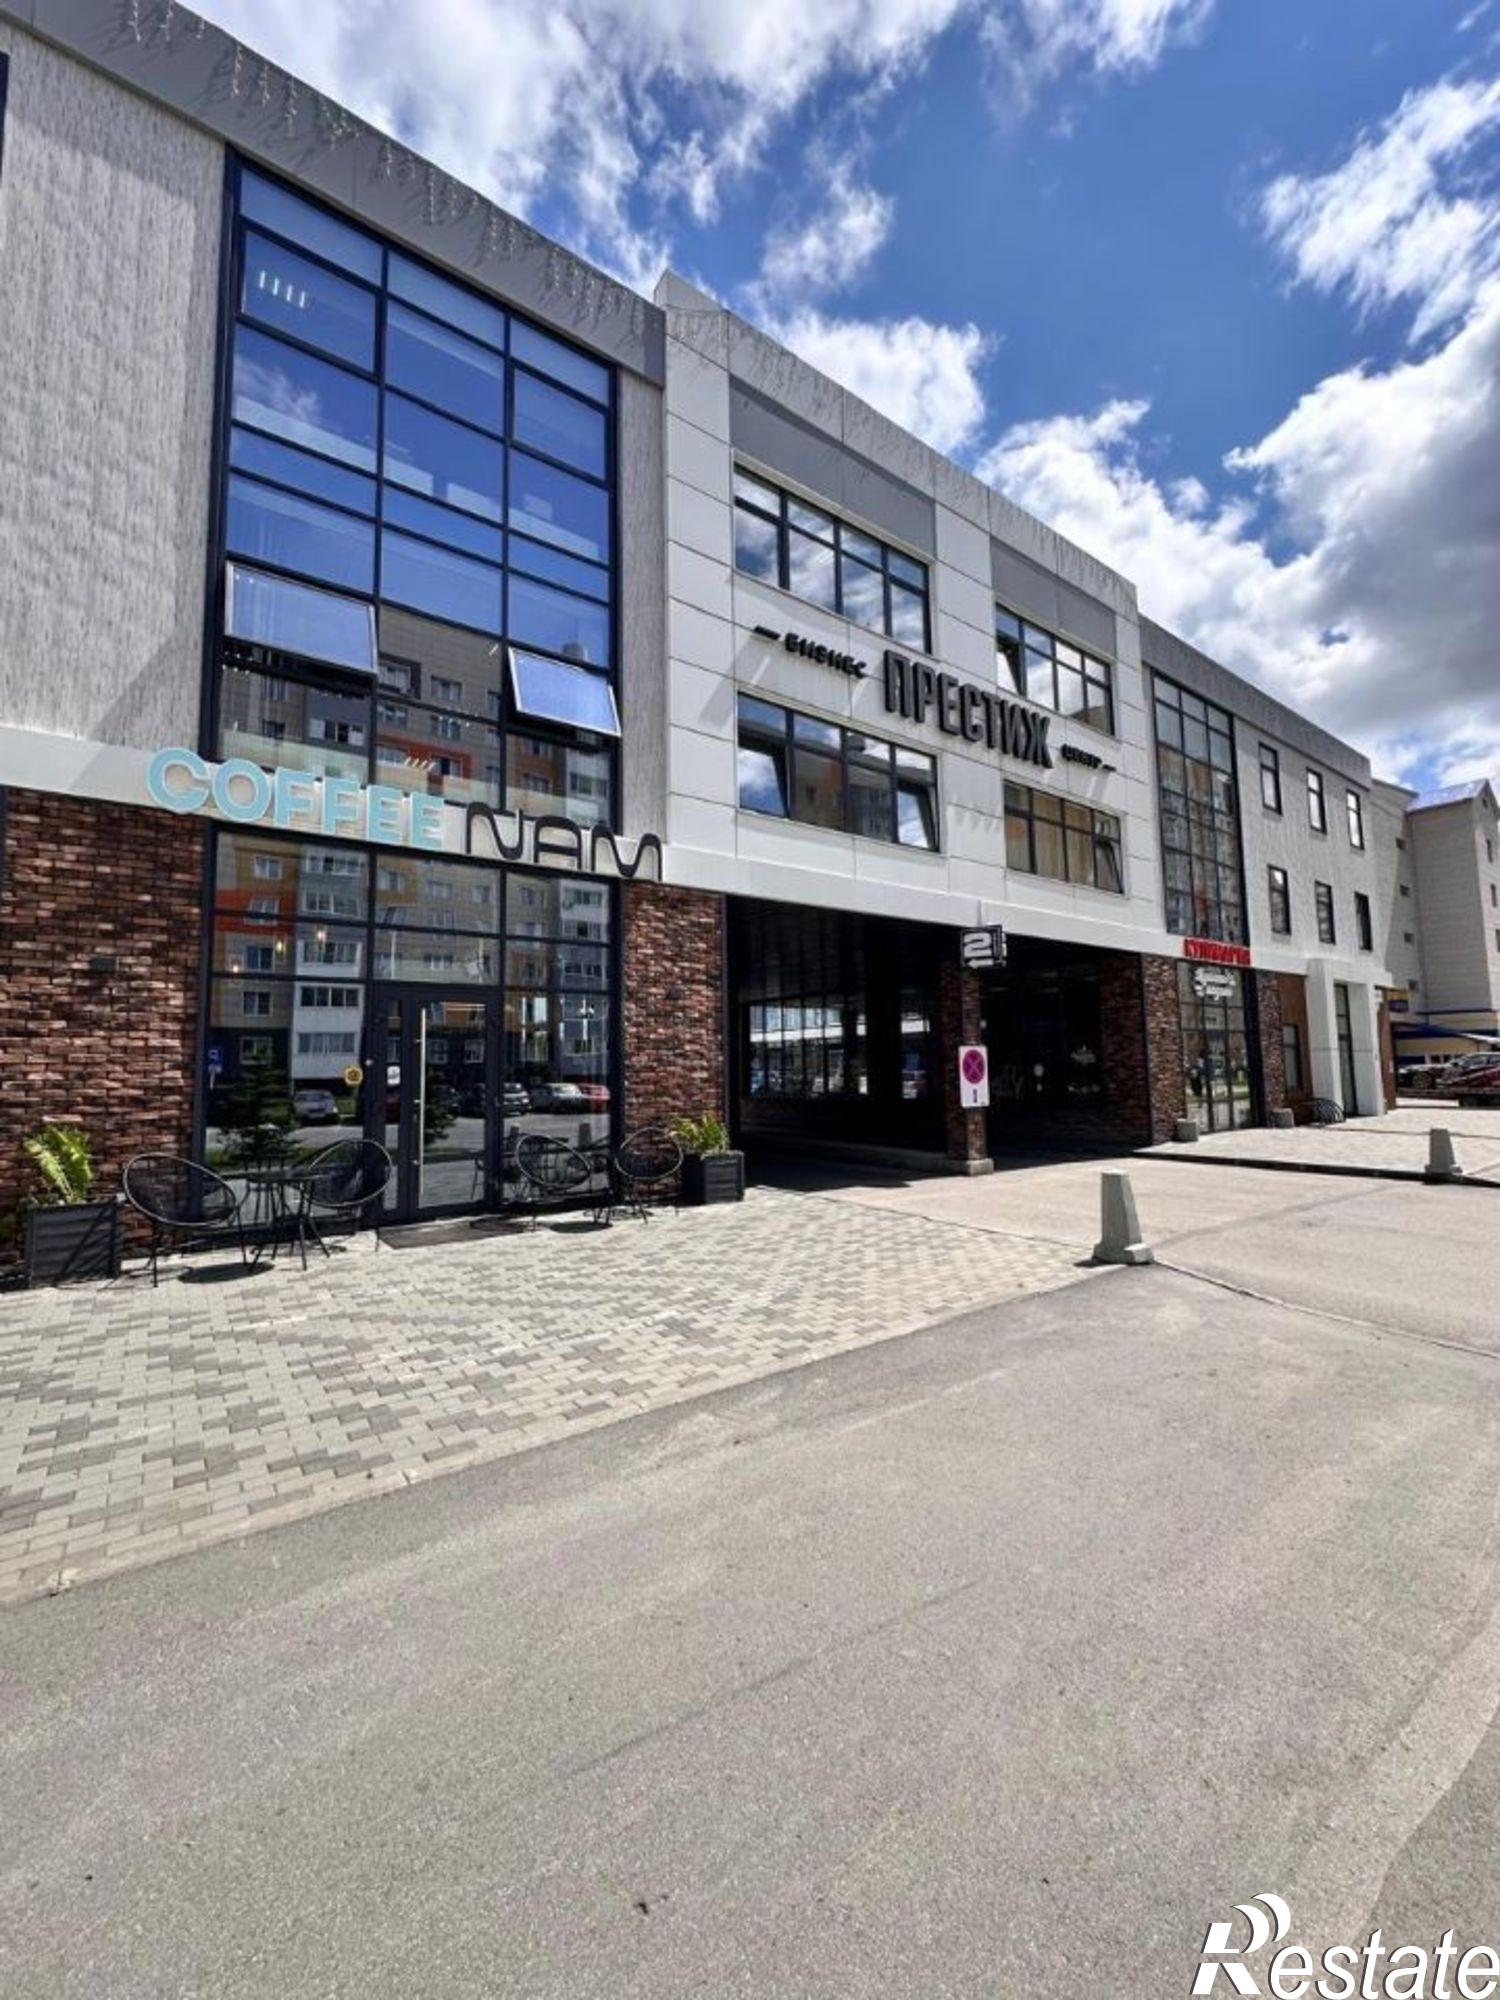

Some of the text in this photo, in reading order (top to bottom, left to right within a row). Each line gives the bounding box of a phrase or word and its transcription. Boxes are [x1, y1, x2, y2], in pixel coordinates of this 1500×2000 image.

[883, 649, 1053, 768] ПРЕСТИЖ
[147, 747, 663, 881] COFFEE NAM
